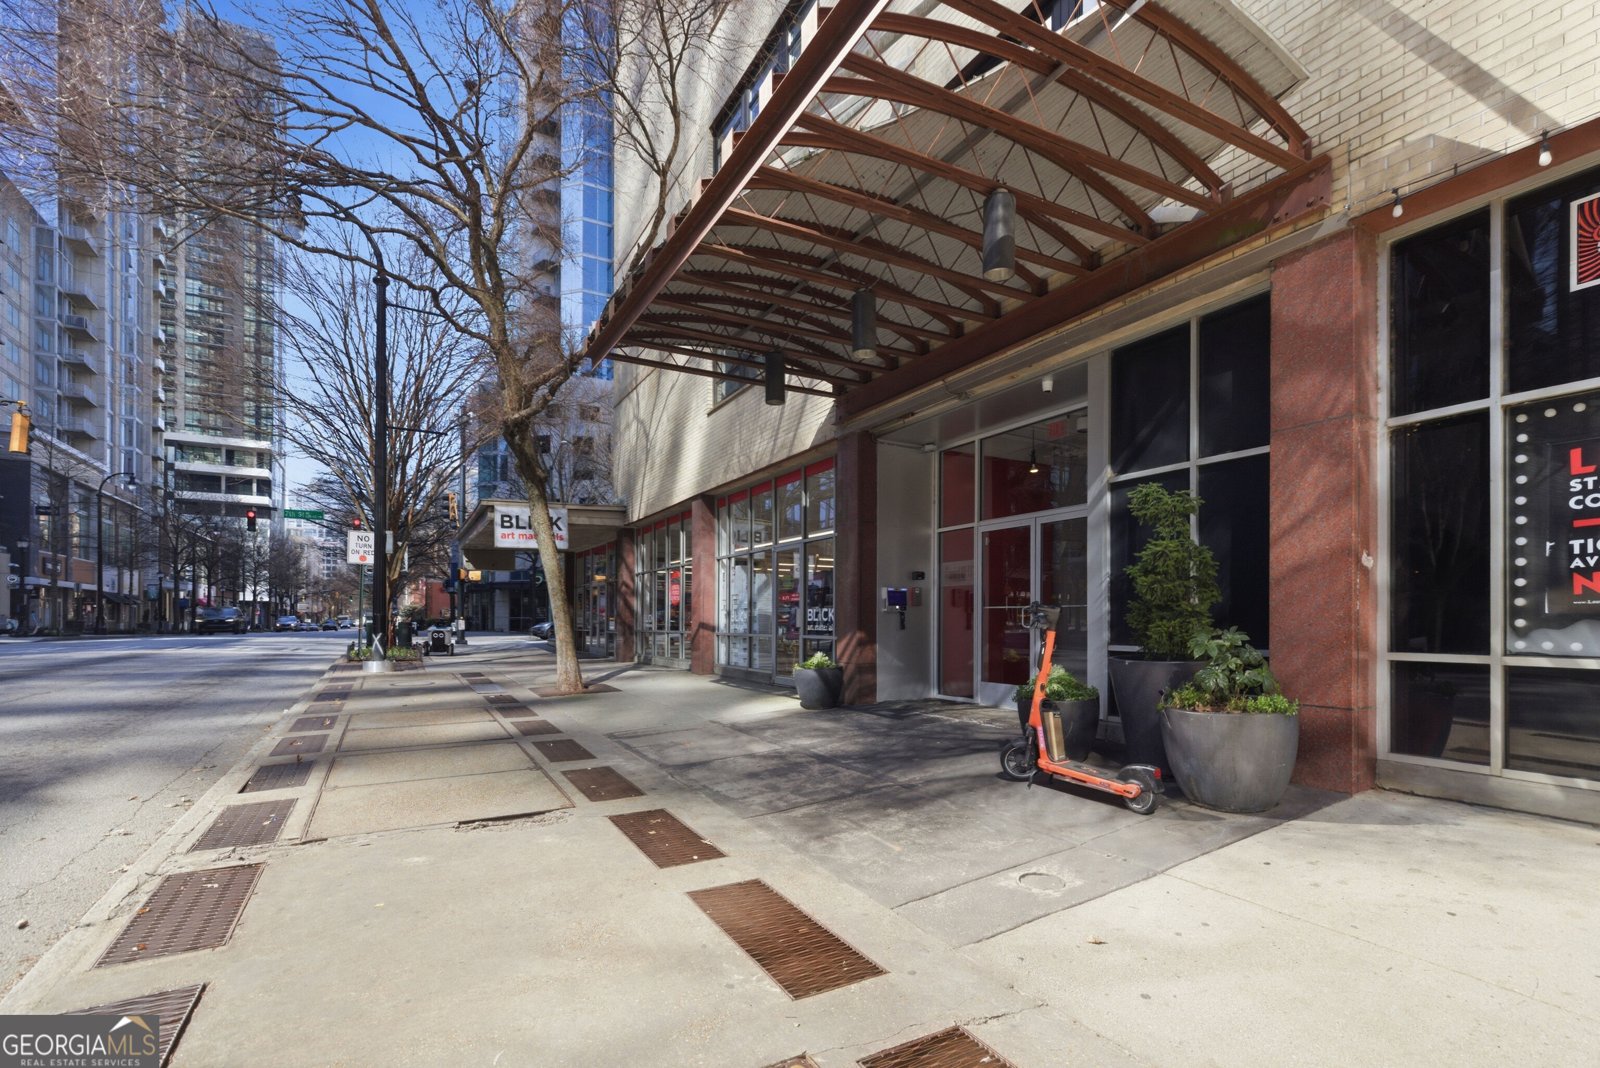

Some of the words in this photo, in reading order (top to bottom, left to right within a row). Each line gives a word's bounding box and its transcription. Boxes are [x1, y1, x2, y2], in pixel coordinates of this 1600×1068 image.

[1569, 476, 1600, 492] ST
[500, 514, 563, 531] BLIK
[500, 531, 515, 540] art
[1568, 538, 1600, 554] TI
